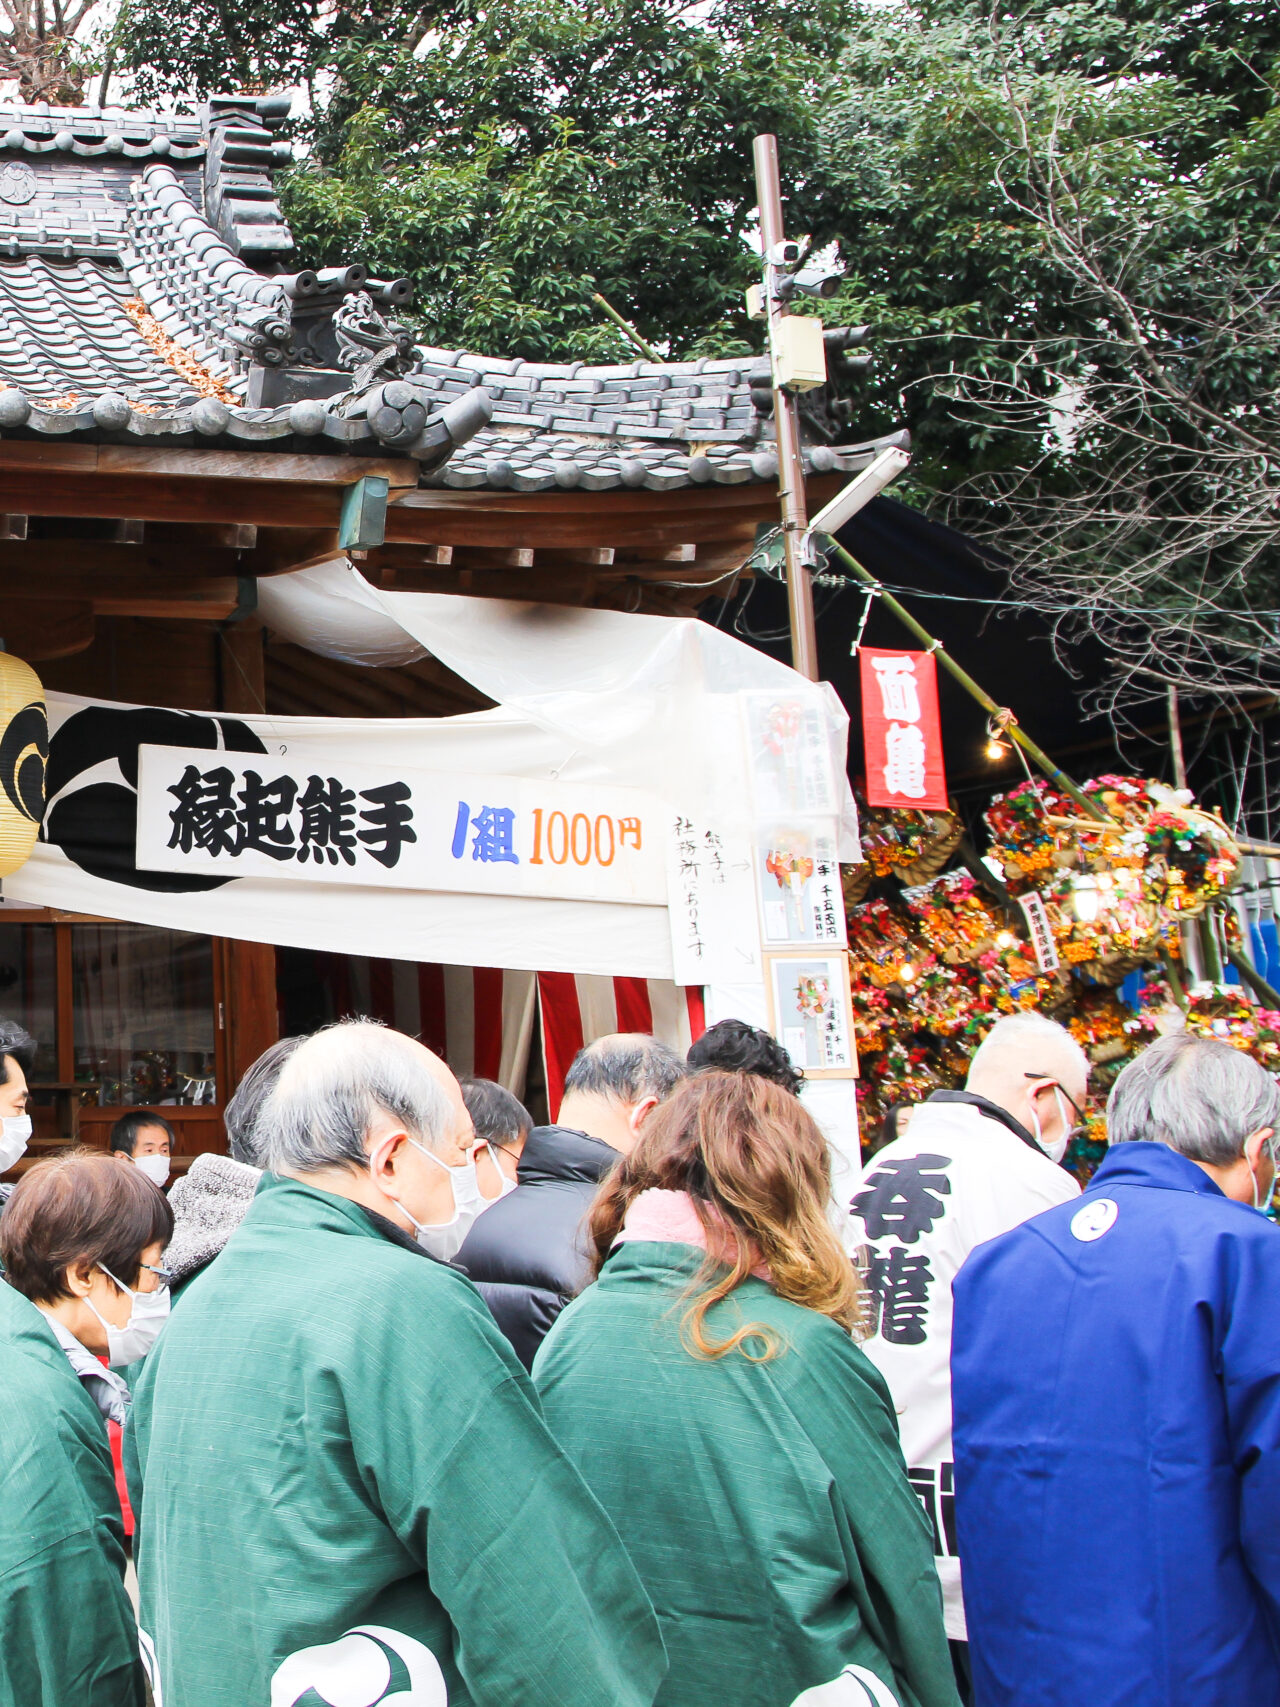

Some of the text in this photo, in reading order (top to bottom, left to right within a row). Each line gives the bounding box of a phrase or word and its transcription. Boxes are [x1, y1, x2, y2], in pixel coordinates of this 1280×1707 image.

[166, 764, 417, 868] 縁起熊手
[529, 808, 642, 866] 1000円
[673, 816, 705, 960] 社務所にあります
